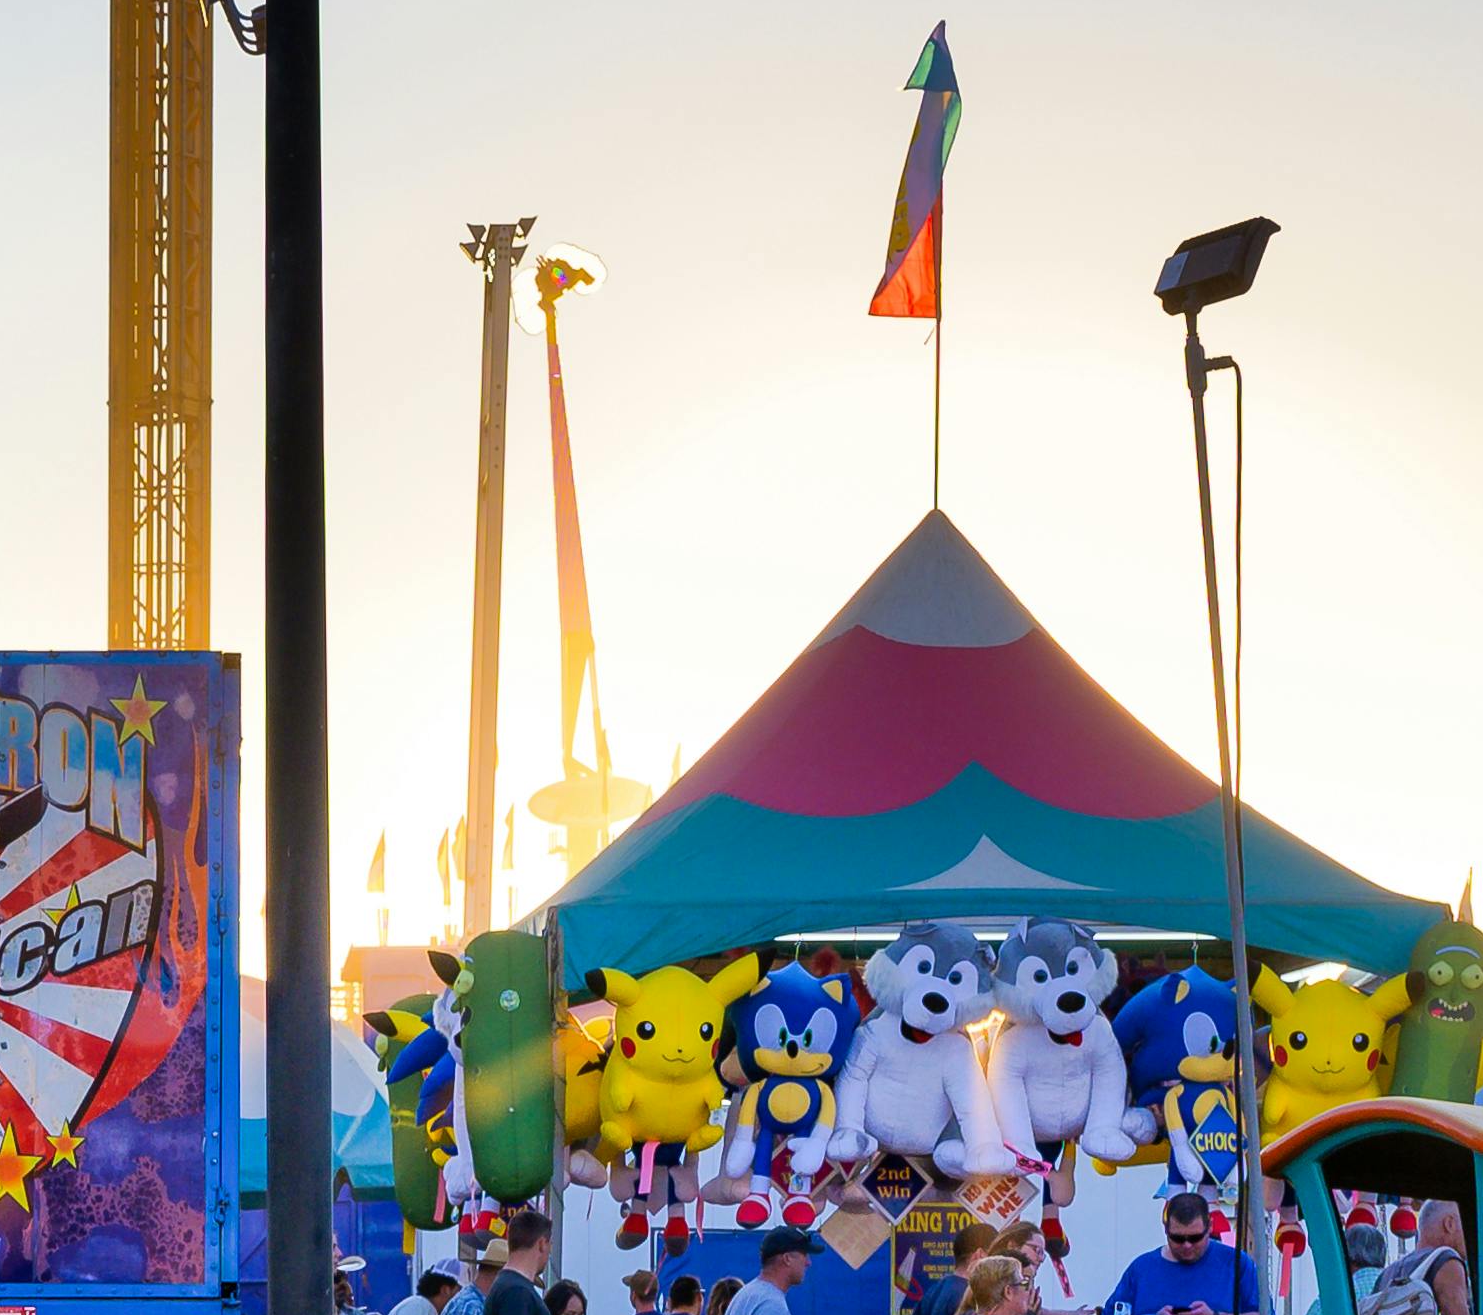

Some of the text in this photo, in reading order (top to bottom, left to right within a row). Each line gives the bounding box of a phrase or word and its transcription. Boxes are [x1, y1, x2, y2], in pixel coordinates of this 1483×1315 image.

[1195, 1131, 1238, 1153] CHOIC
[877, 1167, 911, 1181] 2nd
[976, 1174, 1020, 1216] WINS
[995, 1190, 1024, 1219] ME
[896, 1211, 981, 1233] RING TO
